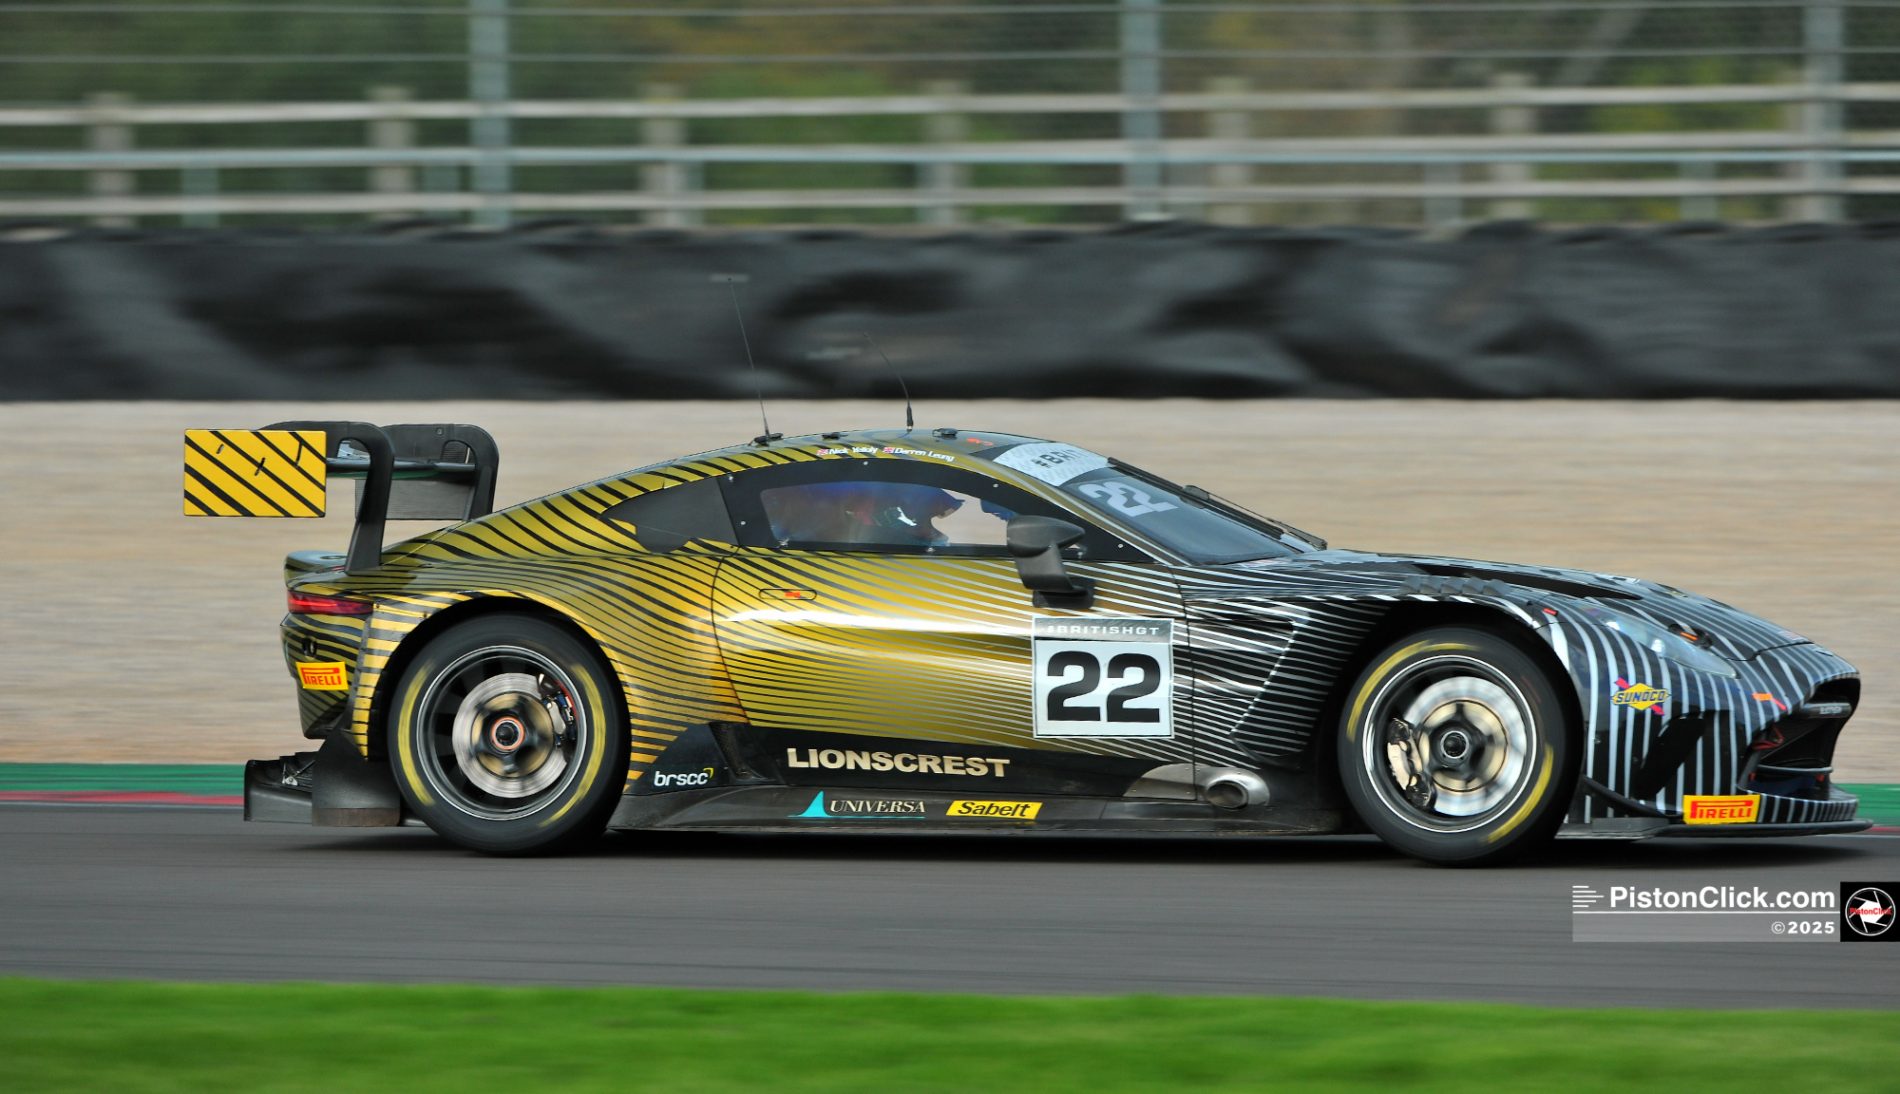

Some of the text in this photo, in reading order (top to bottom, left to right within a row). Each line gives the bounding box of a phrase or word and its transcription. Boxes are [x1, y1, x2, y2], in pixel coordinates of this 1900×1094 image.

[895, 448, 954, 462] Darren Leung
[1079, 481, 1179, 517] 22
[300, 667, 342, 686] PIRELLI
[1047, 650, 1161, 723] 22
[1616, 690, 1665, 703] SUNOCO
[787, 748, 1011, 778] LIONSCREST
[654, 770, 709, 787] brscc
[830, 800, 926, 814] UNIVERSA
[957, 801, 1031, 818] Sabelt
[1690, 799, 1754, 819] PIRELLI
